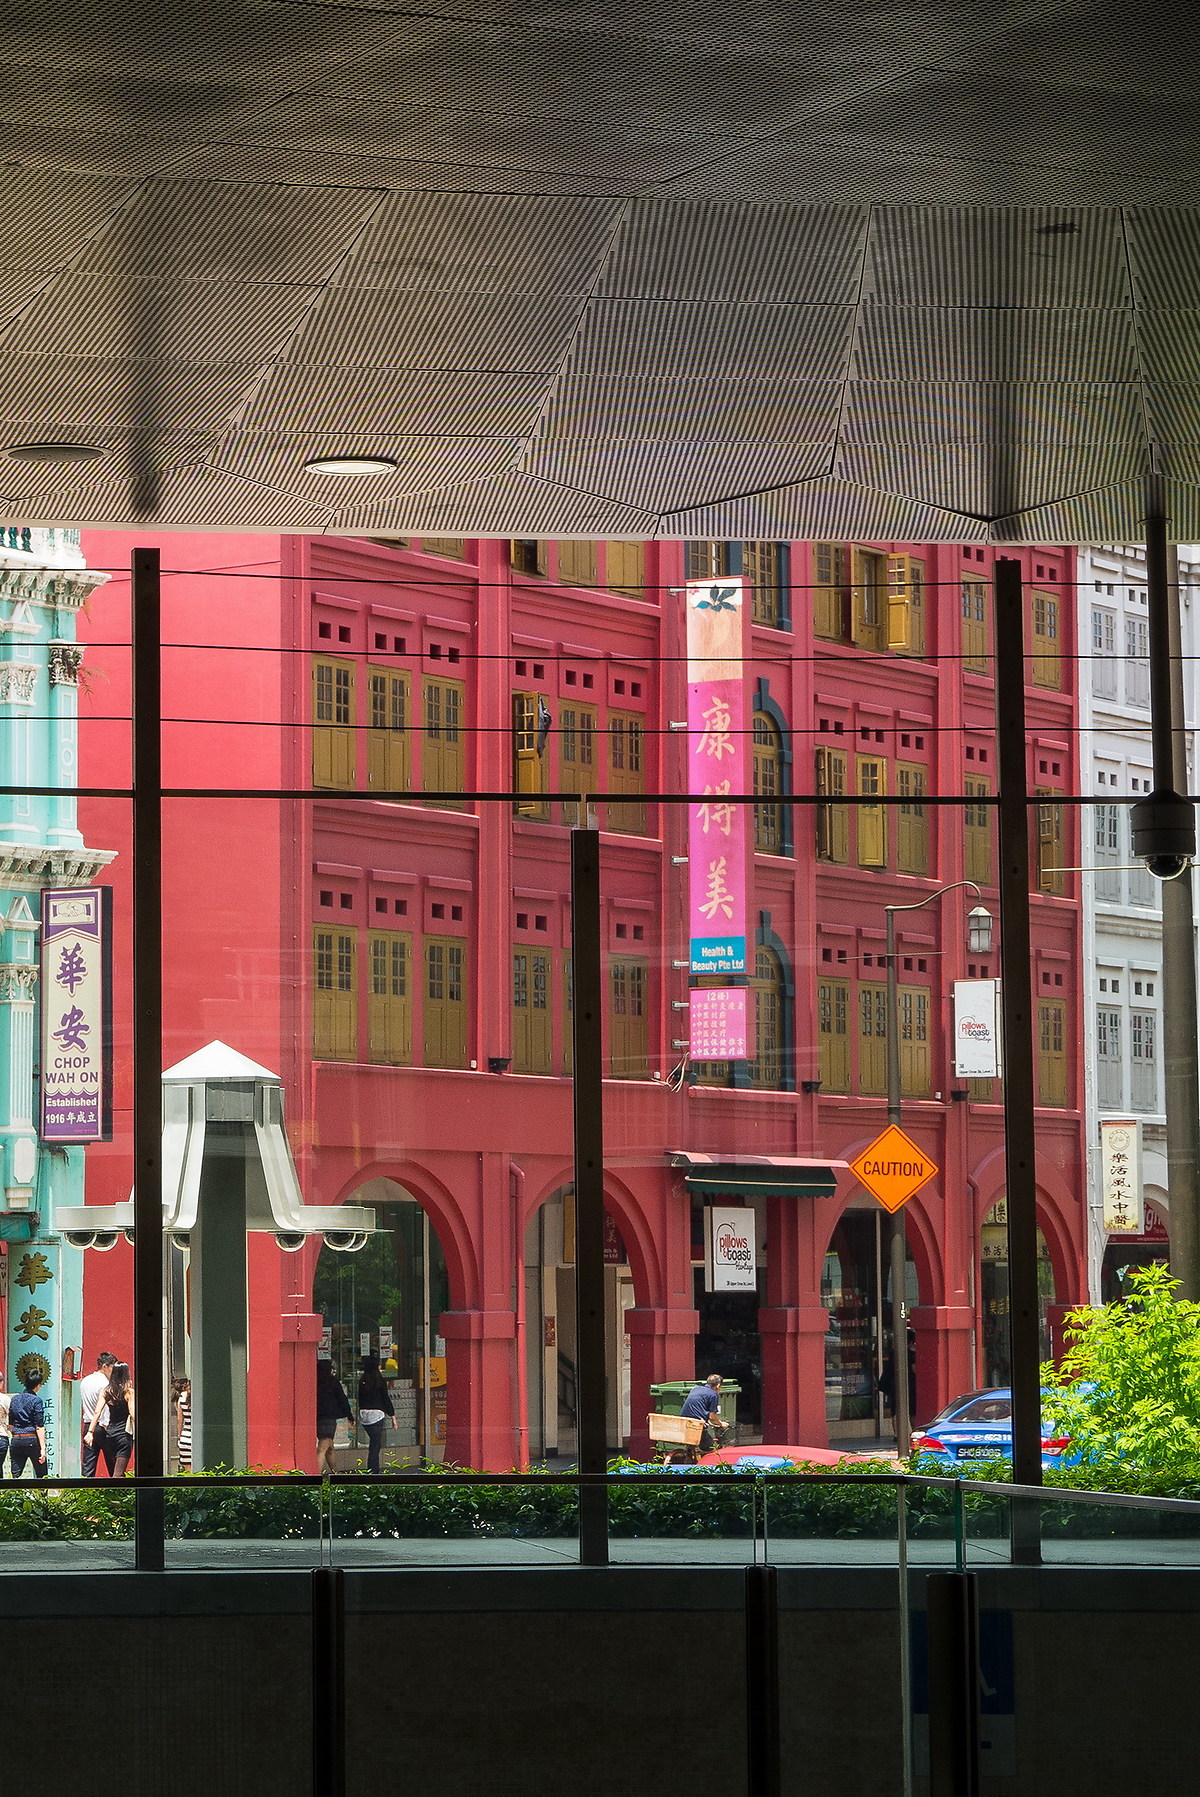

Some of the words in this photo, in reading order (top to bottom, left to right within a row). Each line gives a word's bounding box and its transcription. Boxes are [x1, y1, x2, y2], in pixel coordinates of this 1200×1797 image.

[702, 946, 726, 957] Health
[727, 946, 734, 956] &
[692, 961, 717, 972] Beauty
[719, 960, 730, 970] Pte
[732, 959, 744, 969] Ltd
[53, 942, 90, 1050] 華安
[962, 1021, 986, 1032] pillows
[54, 1057, 90, 1068] CHOP
[45, 1073, 75, 1083] WAH
[80, 1072, 98, 1082] ON
[46, 1097, 97, 1107] Established
[863, 1161, 923, 1177] CAUTION
[720, 1234, 747, 1252] pillows
[728, 1248, 751, 1260] toast
[14, 1252, 54, 1342] 華安
[901, 1302, 905, 1318] 15
